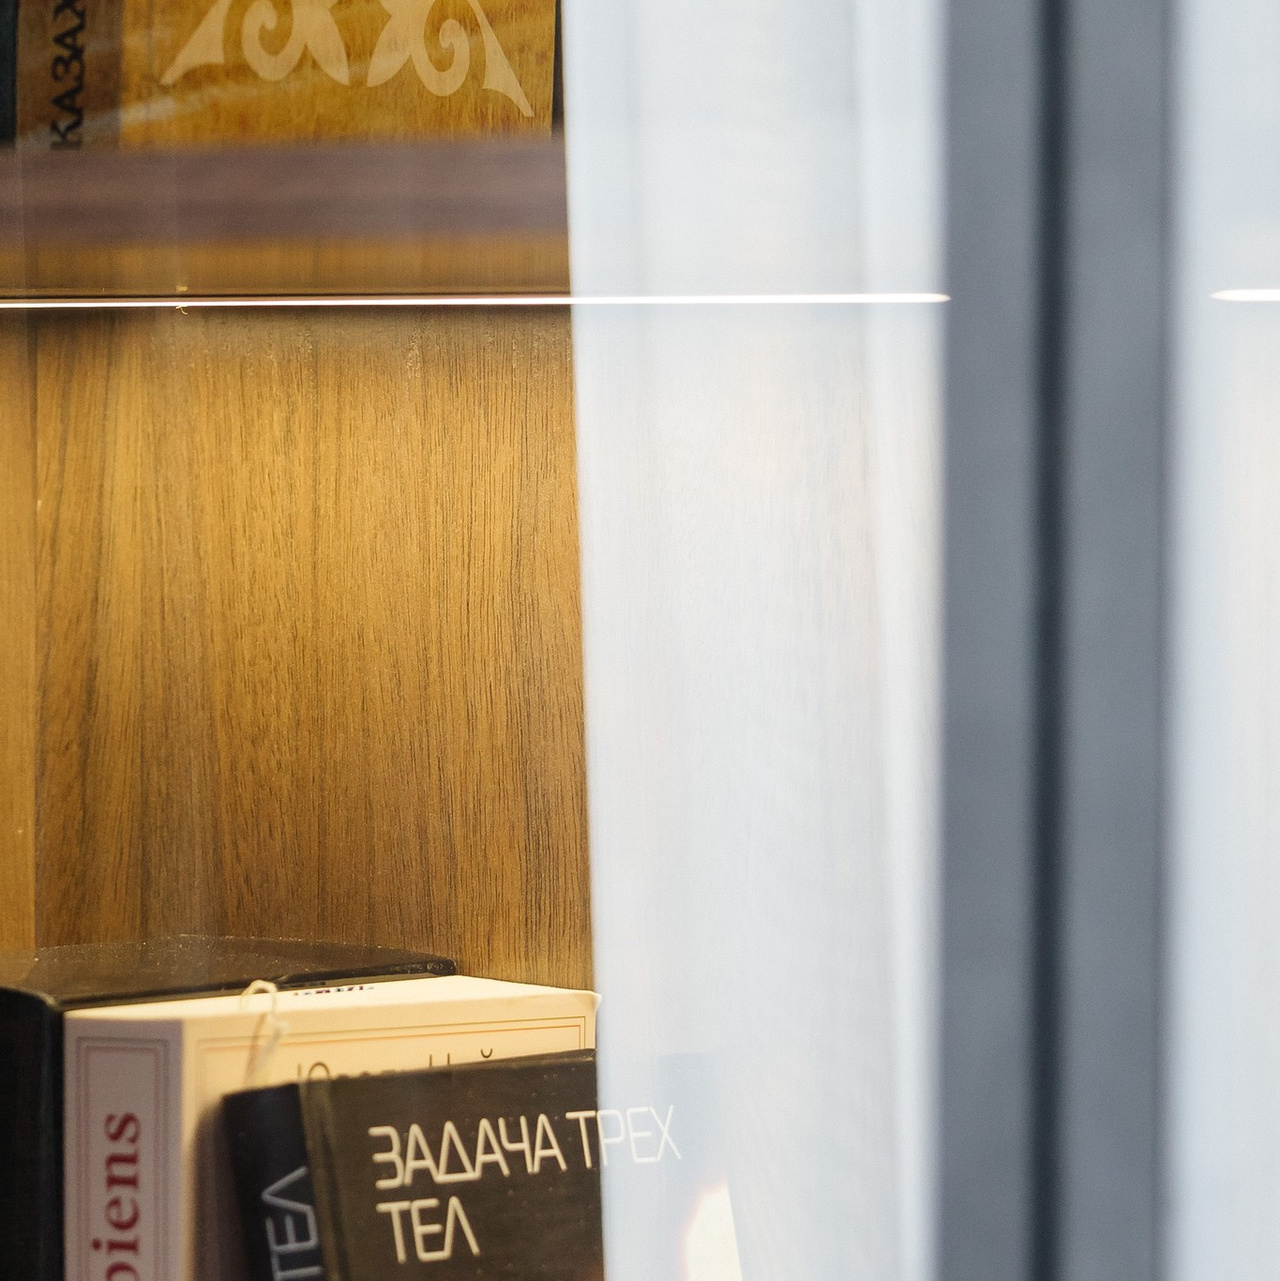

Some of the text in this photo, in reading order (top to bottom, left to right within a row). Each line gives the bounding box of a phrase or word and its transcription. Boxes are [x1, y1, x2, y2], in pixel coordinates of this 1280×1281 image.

[368, 1104, 682, 1191] ЗАДАЧА ТРЕХ
[375, 1195, 481, 1264] ТЕЛ
